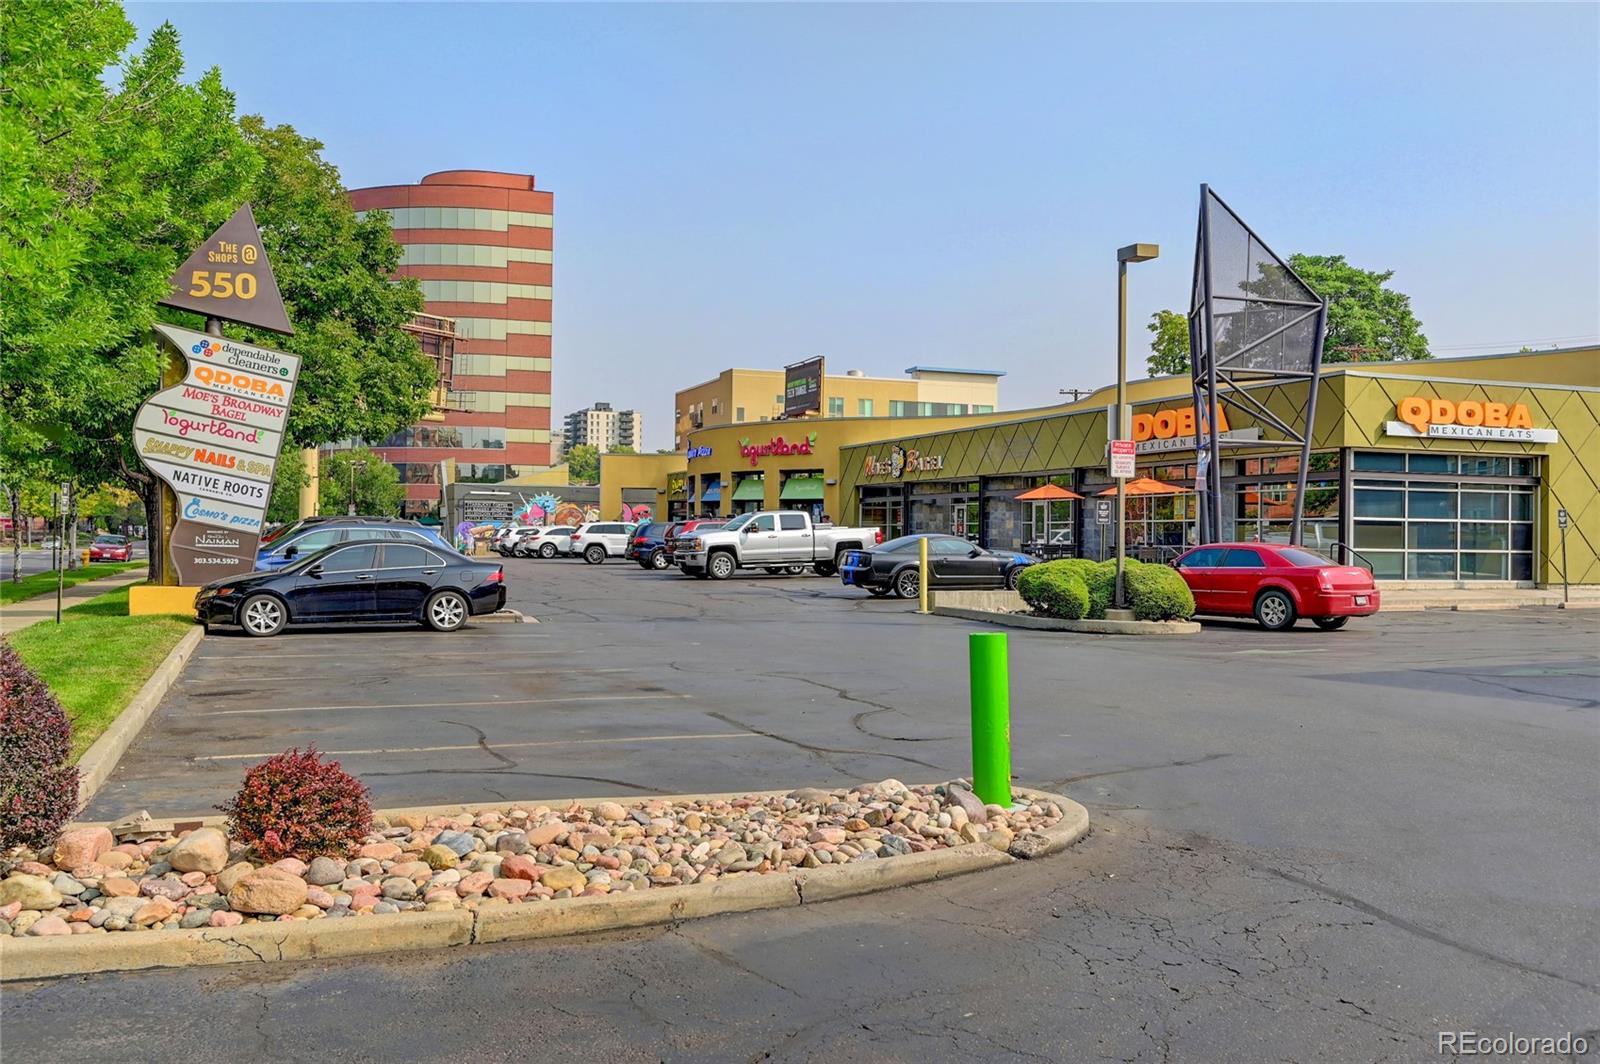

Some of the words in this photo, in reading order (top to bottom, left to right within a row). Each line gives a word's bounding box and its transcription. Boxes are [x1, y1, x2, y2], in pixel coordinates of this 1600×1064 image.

[208, 251, 238, 263] SHOPS
[241, 244, 257, 264] @
[219, 241, 238, 253] THE
[189, 271, 257, 299] 550
[222, 343, 281, 365] dependable
[228, 354, 279, 375] cleaners
[194, 366, 285, 397] QDOBA
[213, 383, 256, 397] MEXICAN
[260, 394, 283, 402] EATS
[182, 387, 219, 403] MOE'S
[221, 395, 284, 418] BROADWAY
[210, 405, 247, 421] BAGEL
[1132, 403, 1230, 441] DOBA
[1396, 396, 1533, 433] QDOBA
[162, 409, 258, 443] Yogurtland
[1430, 426, 1493, 437] MEXICAN
[1499, 429, 1532, 439] EATS
[738, 435, 813, 466] Yogurtland
[1193, 434, 1225, 445] EAS
[143, 437, 195, 459] SNAPPY
[193, 448, 236, 468] NAILS
[246, 460, 271, 477] SPA
[173, 470, 220, 490] NATIVE
[224, 482, 264, 498] ROOTS
[195, 534, 240, 545] NAIMAN
[194, 557, 239, 565] 303.534.5929
